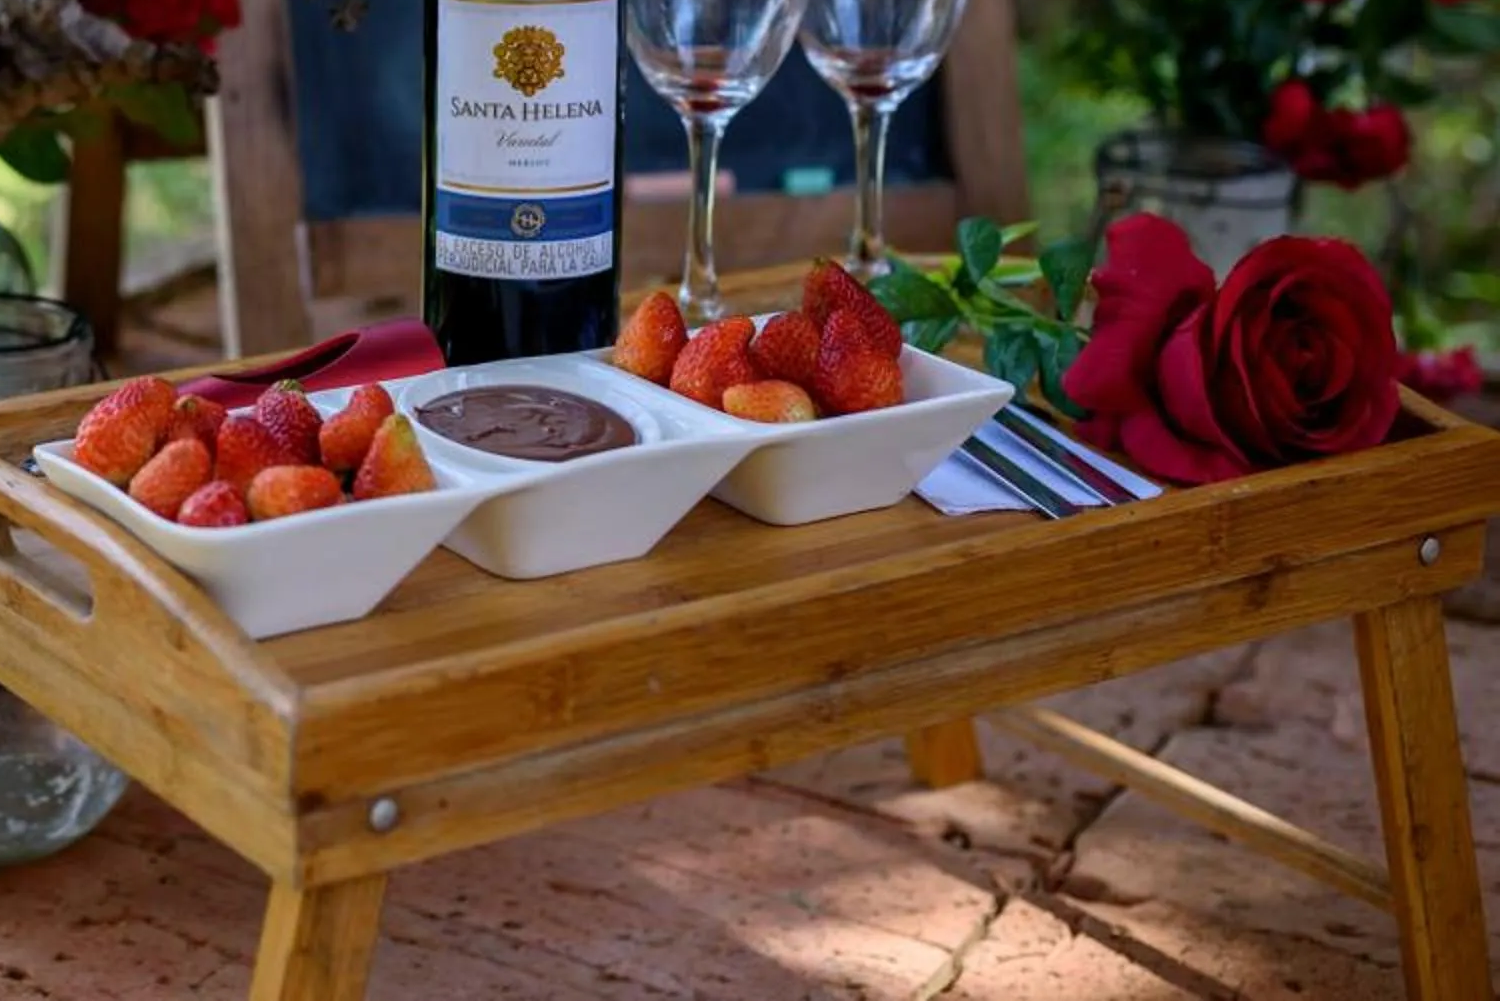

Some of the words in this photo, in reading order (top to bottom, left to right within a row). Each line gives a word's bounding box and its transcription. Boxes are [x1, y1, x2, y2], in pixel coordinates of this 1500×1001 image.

[450, 96, 516, 120] SANTA
[522, 99, 603, 122] HELENA
[454, 240, 505, 258] EXCESO
[513, 245, 531, 260] DE
[540, 238, 597, 258] ALCOHOL
[438, 251, 513, 274] PERJUDICIAL
[521, 258, 557, 275] PARA
[562, 258, 578, 272] LA
